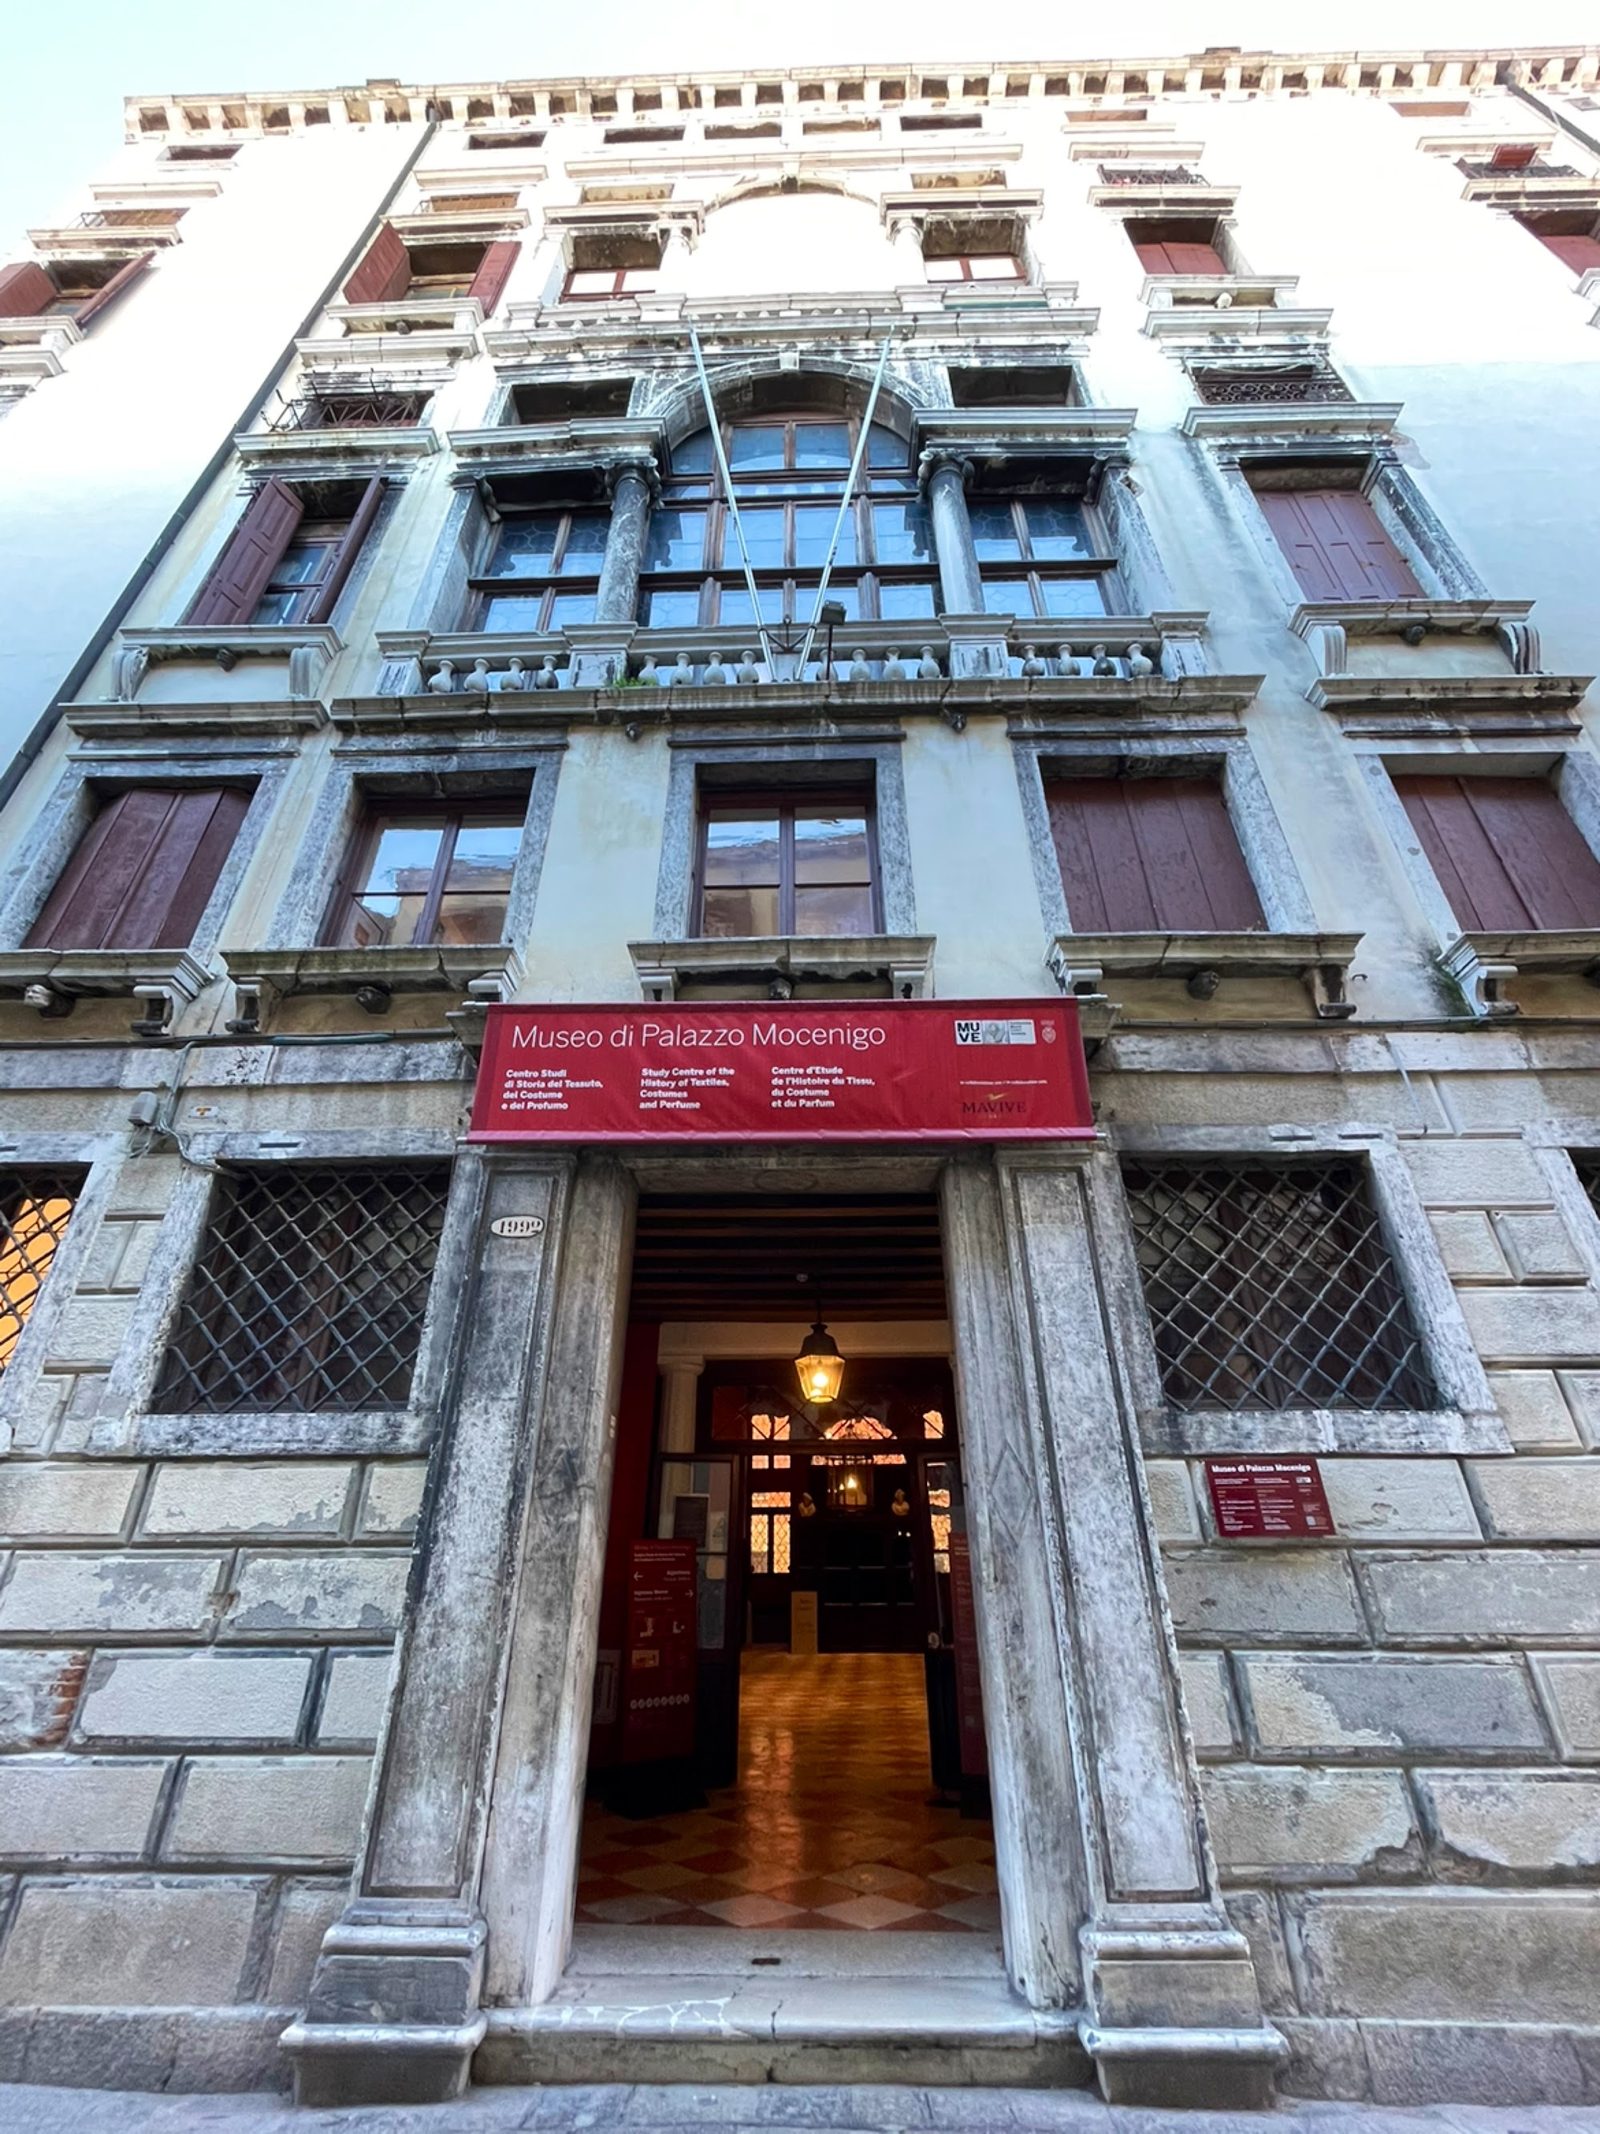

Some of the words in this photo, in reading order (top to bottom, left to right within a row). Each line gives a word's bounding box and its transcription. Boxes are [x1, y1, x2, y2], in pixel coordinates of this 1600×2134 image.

[957, 1022, 980, 1032] MU
[512, 1025, 603, 1048] Museo
[610, 1025, 634, 1047] di
[642, 1023, 745, 1047] Palazzo
[753, 1022, 886, 1050] Mocenigo
[959, 1033, 981, 1042] VE
[506, 1069, 539, 1078] Centro
[541, 1069, 567, 1078] Studi
[641, 1067, 670, 1078] Study
[672, 1067, 704, 1076] Centre
[705, 1067, 717, 1076] of
[718, 1067, 735, 1076] the
[771, 1066, 804, 1075] Centre
[806, 1066, 843, 1075] d'Etude
[504, 1080, 514, 1089] di
[516, 1080, 545, 1089] Storia
[547, 1080, 562, 1088] del
[565, 1079, 603, 1089] Tessuto,
[641, 1078, 676, 1089] History
[678, 1078, 688, 1087] of
[690, 1077, 730, 1087] Textiles,
[771, 1077, 784, 1086] de
[786, 1077, 830, 1085] l'Histoire
[832, 1077, 845, 1085] du
[846, 1076, 876, 1086] Tissu,
[503, 1090, 518, 1099] del
[520, 1090, 563, 1099] Costume
[640, 1089, 688, 1098] Costumes
[771, 1088, 784, 1097] du
[786, 1087, 830, 1097] Costume
[510, 1101, 525, 1110] del
[527, 1101, 569, 1110] Profumo
[640, 1100, 657, 1109] and
[659, 1100, 701, 1109] Perfume
[771, 1099, 782, 1108] et
[784, 1099, 797, 1108] du
[799, 1098, 835, 1108] Parfum
[962, 1101, 1026, 1113] MAVIVE
